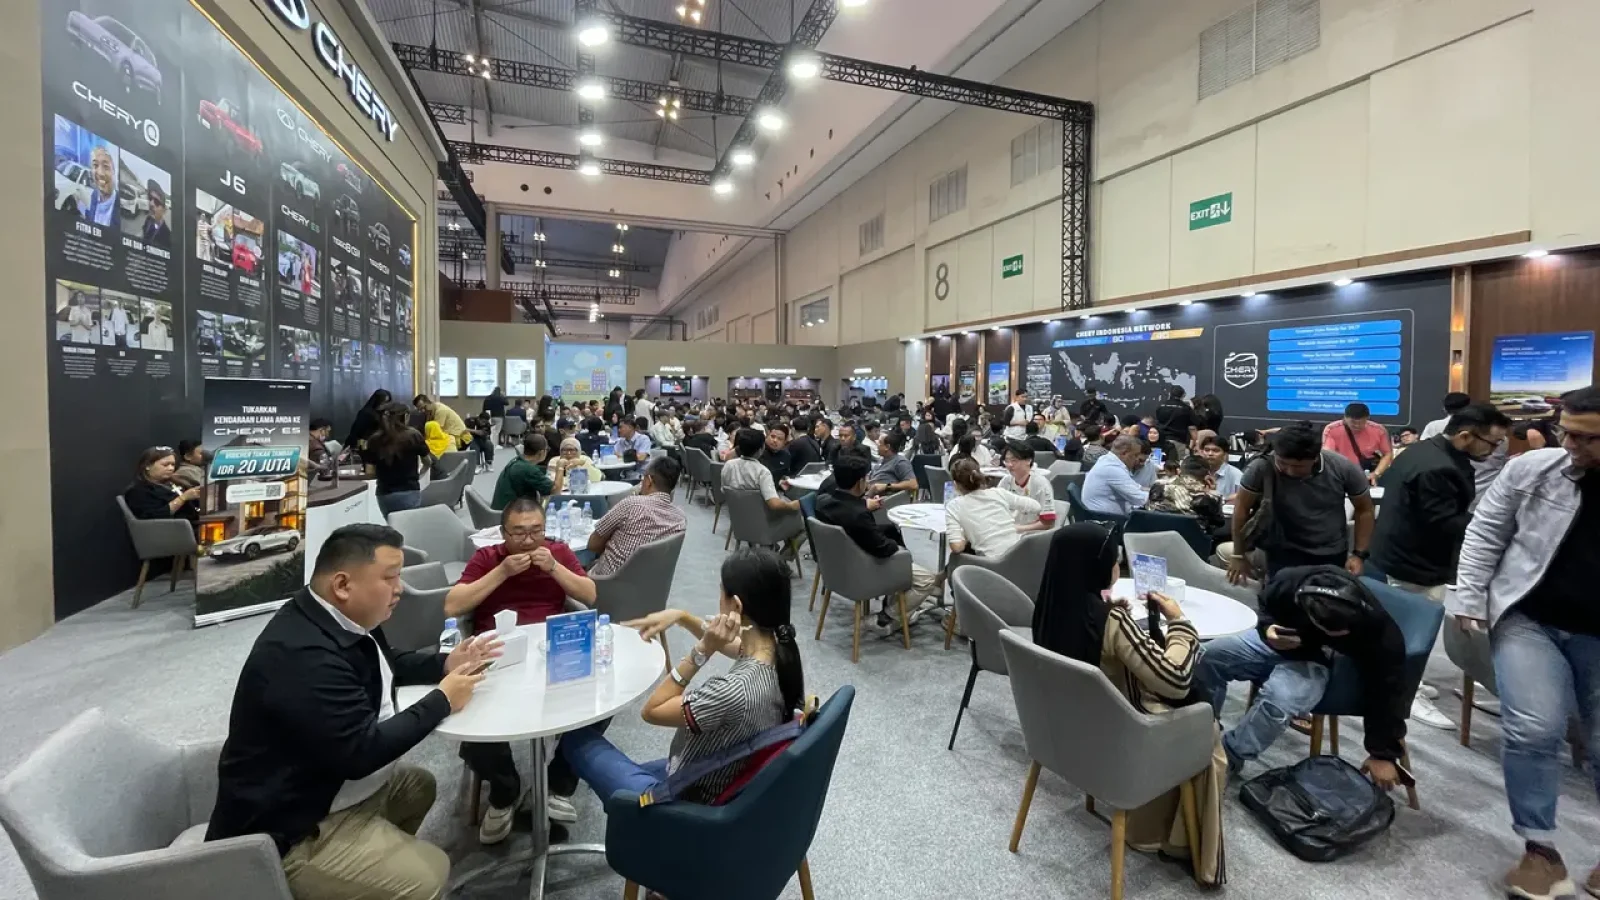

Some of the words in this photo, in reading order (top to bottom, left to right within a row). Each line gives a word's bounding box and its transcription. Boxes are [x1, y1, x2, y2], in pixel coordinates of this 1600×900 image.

[316, 21, 398, 142] CHERY
[72, 81, 142, 130] CHERY
[297, 127, 332, 163] CHERY
[280, 204, 309, 227] CHERY
[1190, 208, 1211, 221] EXIT
[935, 262, 949, 301] 8
[1133, 322, 1171, 332] NETWORK
[242, 405, 277, 414] TUKARKAN
[214, 415, 256, 424] KENDARAAN
[256, 415, 275, 424] LAMA
[275, 415, 292, 423] ANDA
[293, 415, 301, 423] KE
[213, 427, 276, 436] CHERY
[217, 464, 235, 476] IDR
[237, 459, 258, 474] 20
[259, 458, 292, 473] JUTA
